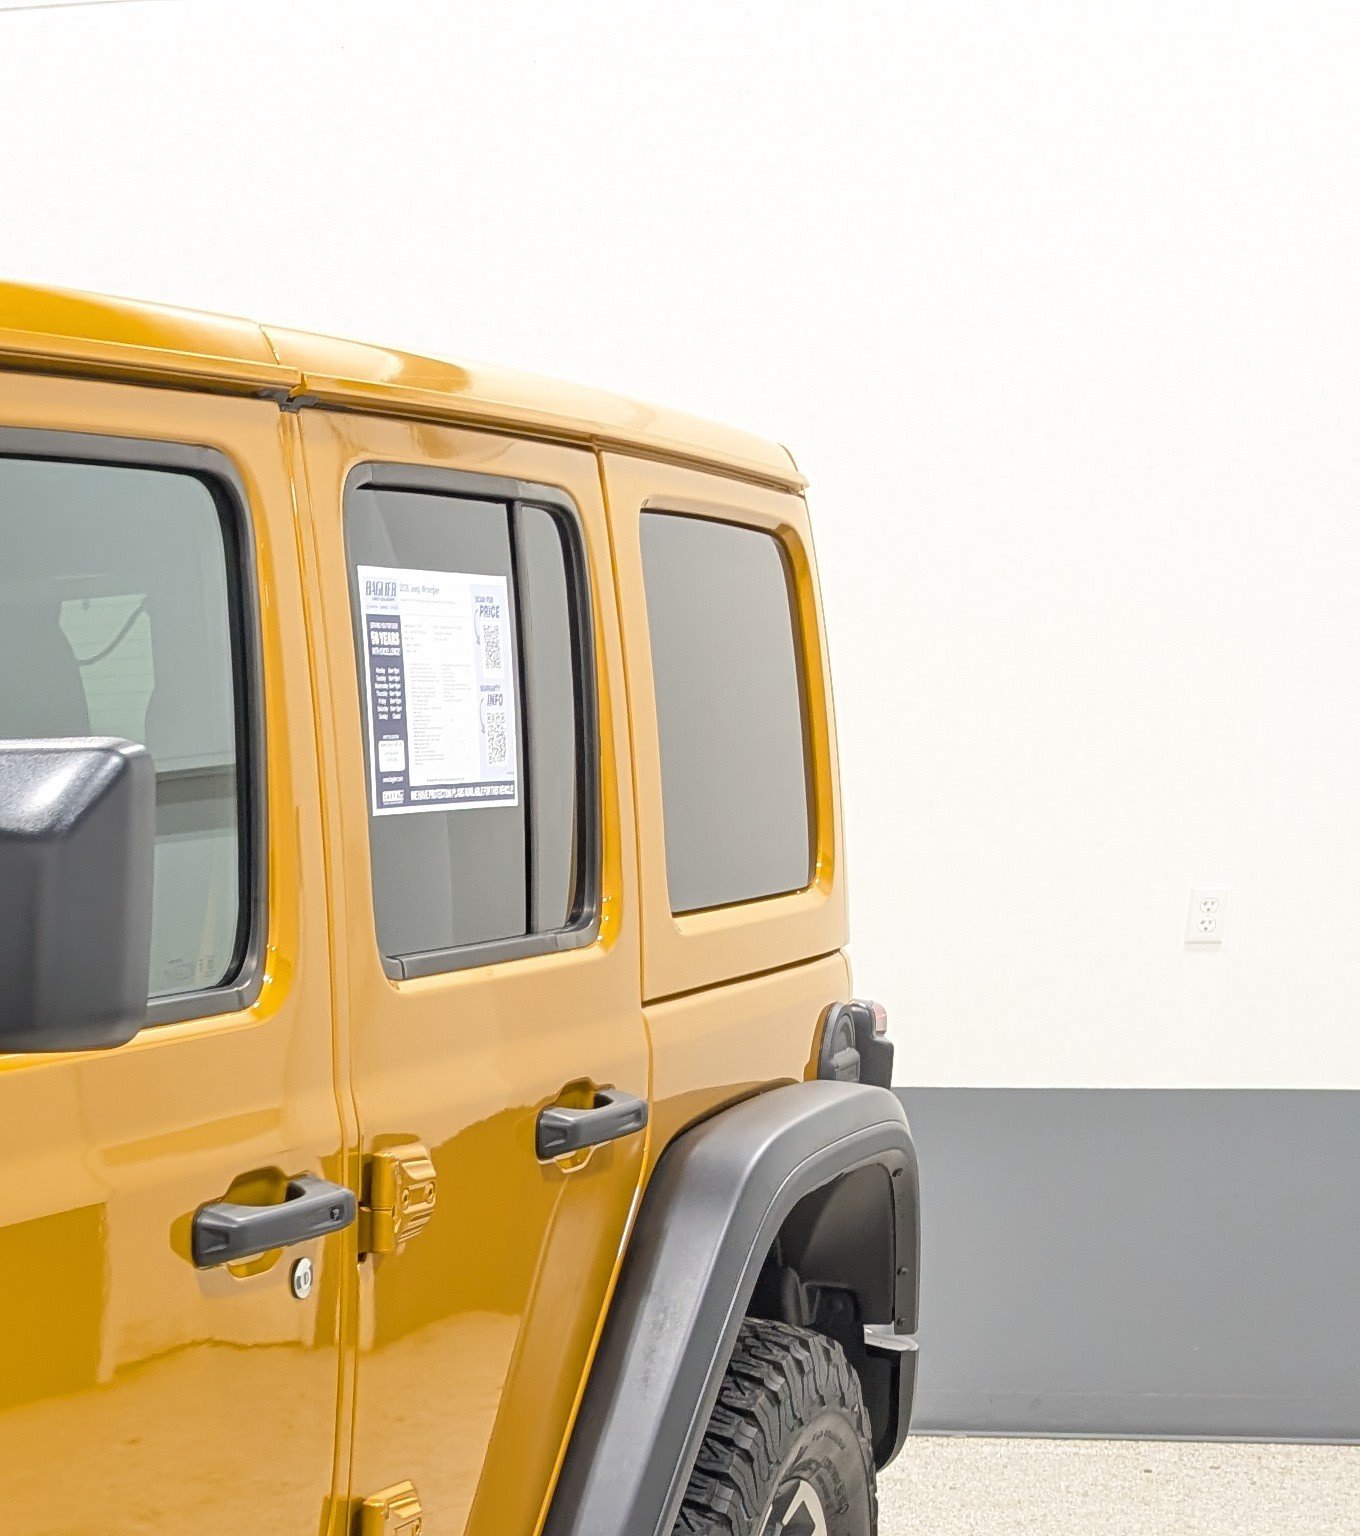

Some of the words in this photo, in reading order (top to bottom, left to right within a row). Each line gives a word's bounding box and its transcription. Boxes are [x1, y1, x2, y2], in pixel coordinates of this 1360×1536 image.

[479, 604, 500, 618] PRICE
[379, 631, 400, 646] YEARS
[487, 693, 503, 706] INFO
